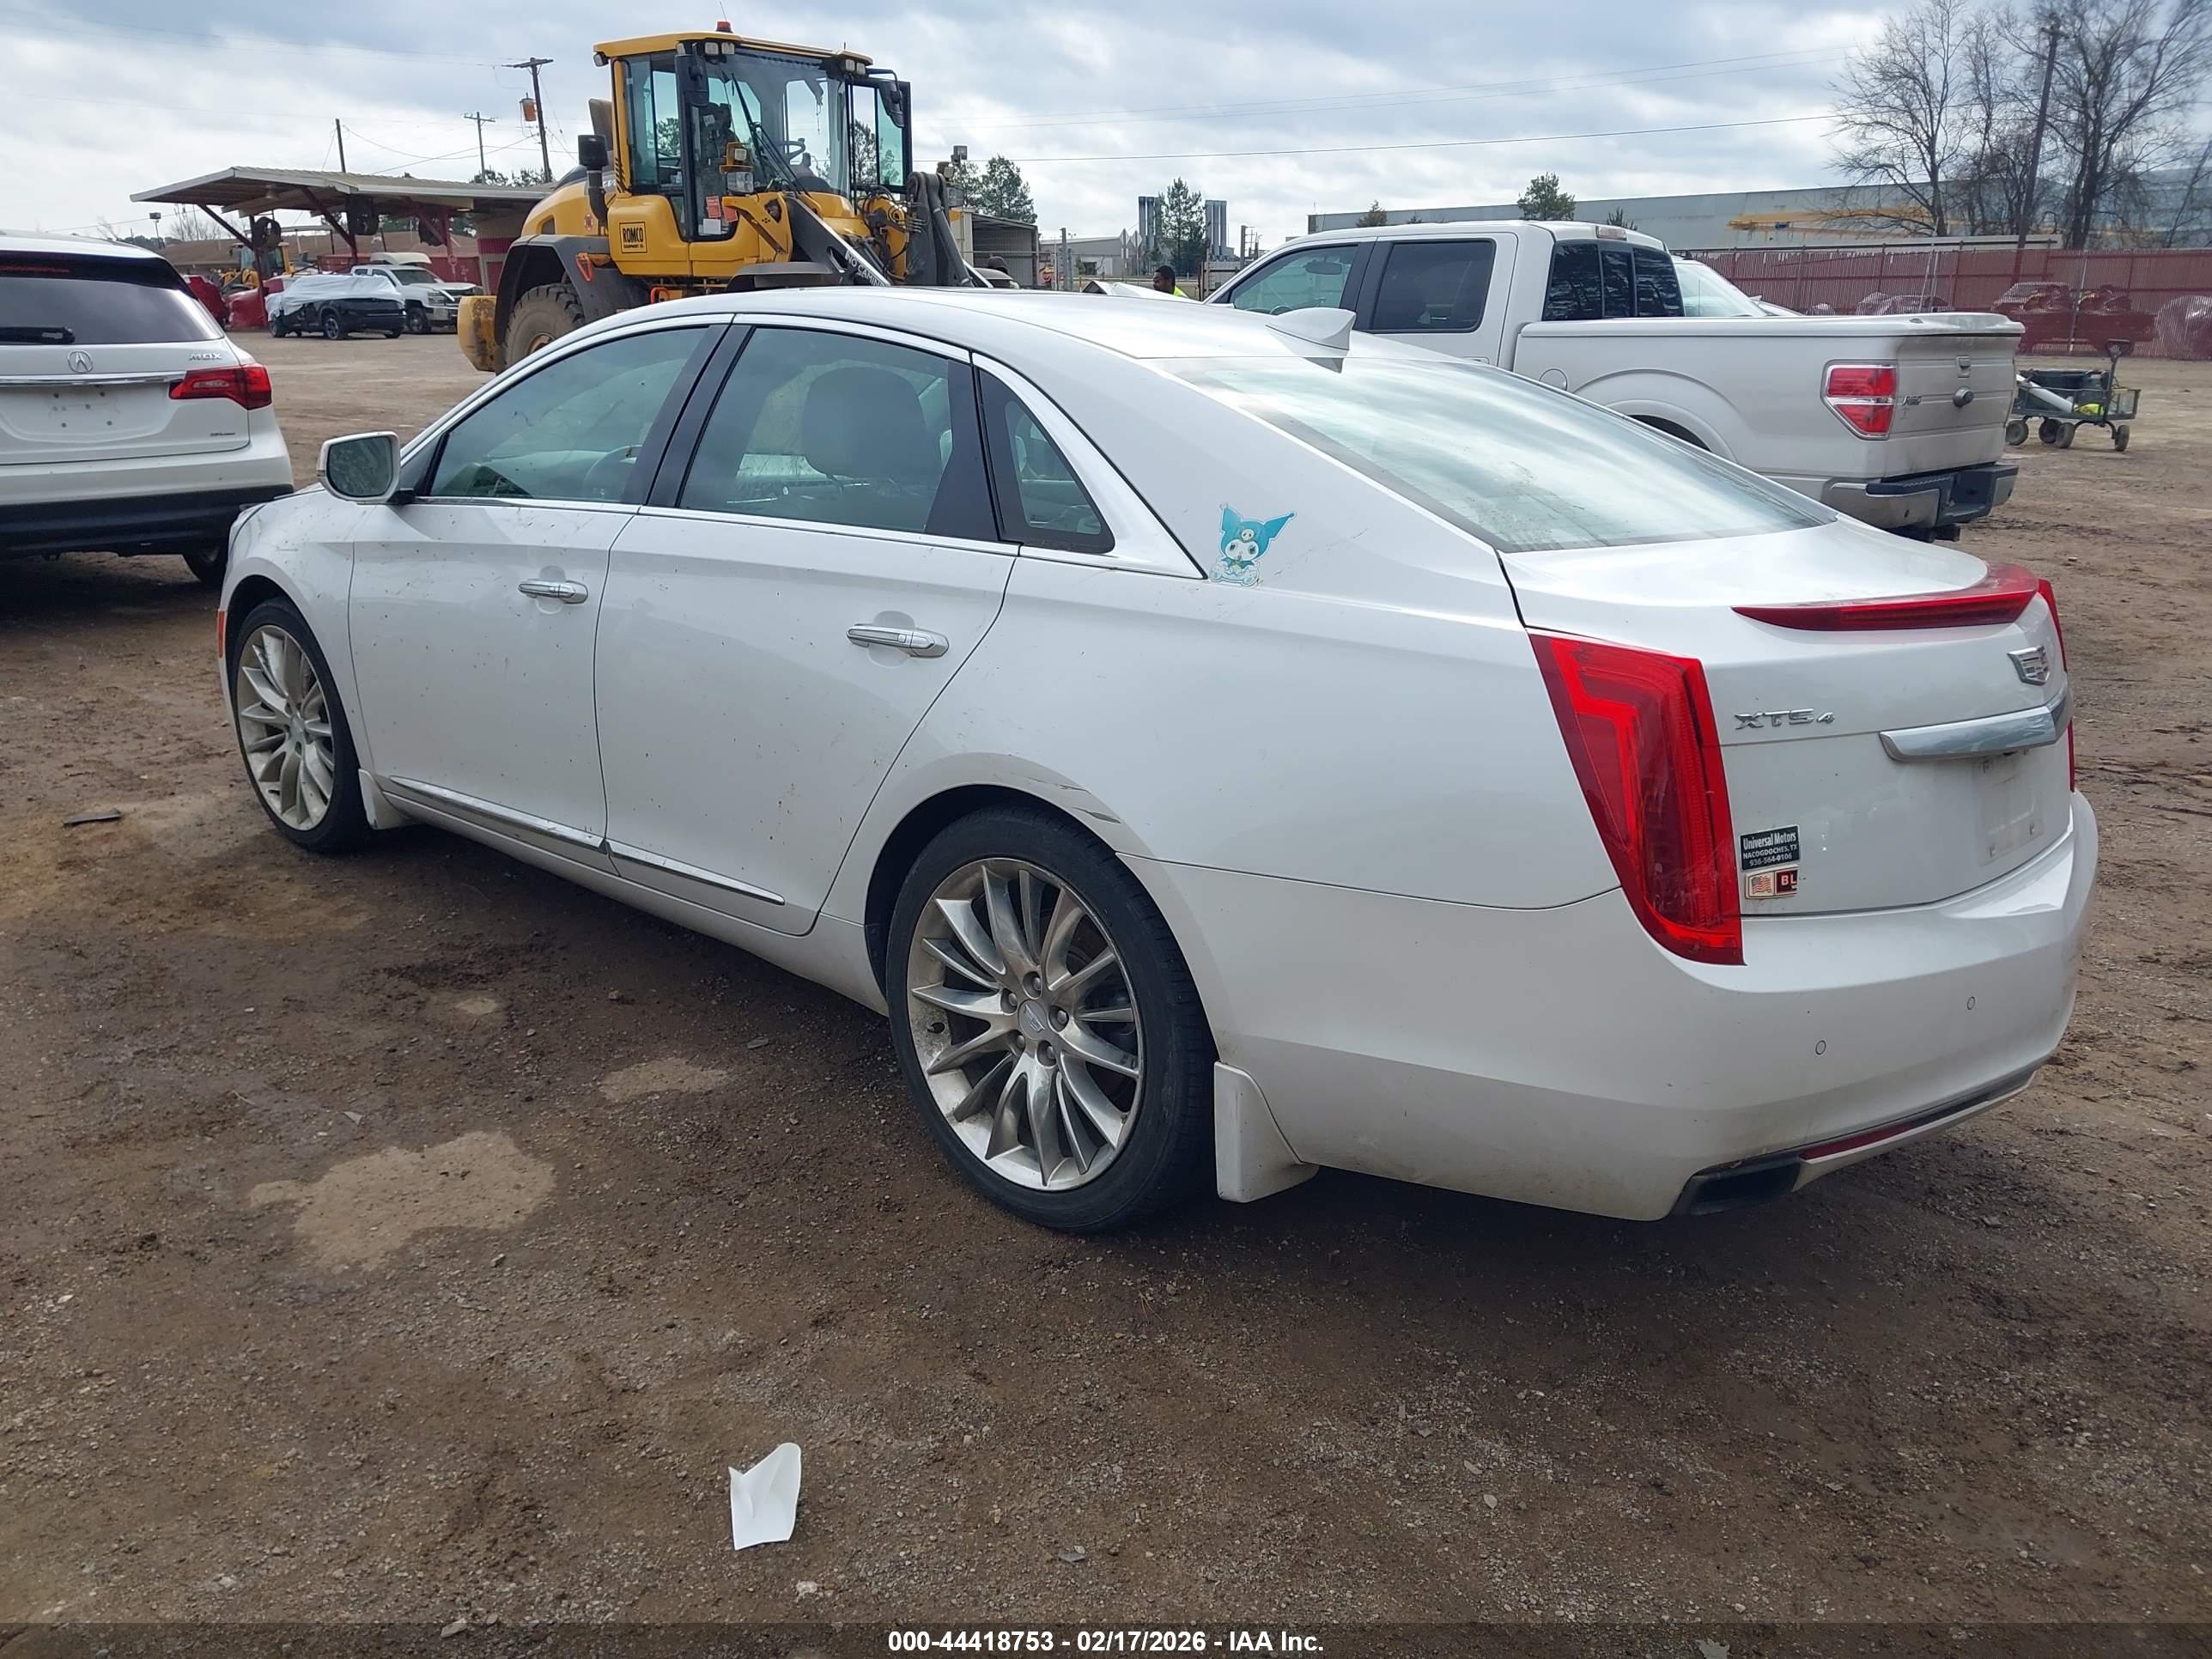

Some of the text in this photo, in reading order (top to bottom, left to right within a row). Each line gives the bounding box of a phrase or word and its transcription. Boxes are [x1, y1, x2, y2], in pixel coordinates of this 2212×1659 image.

[623, 228, 643, 242] ROMCO
[845, 249, 857, 267] NO
[1743, 832, 1796, 849] Universal Motors
[1743, 847, 1789, 859] NACOGDOCHES,
